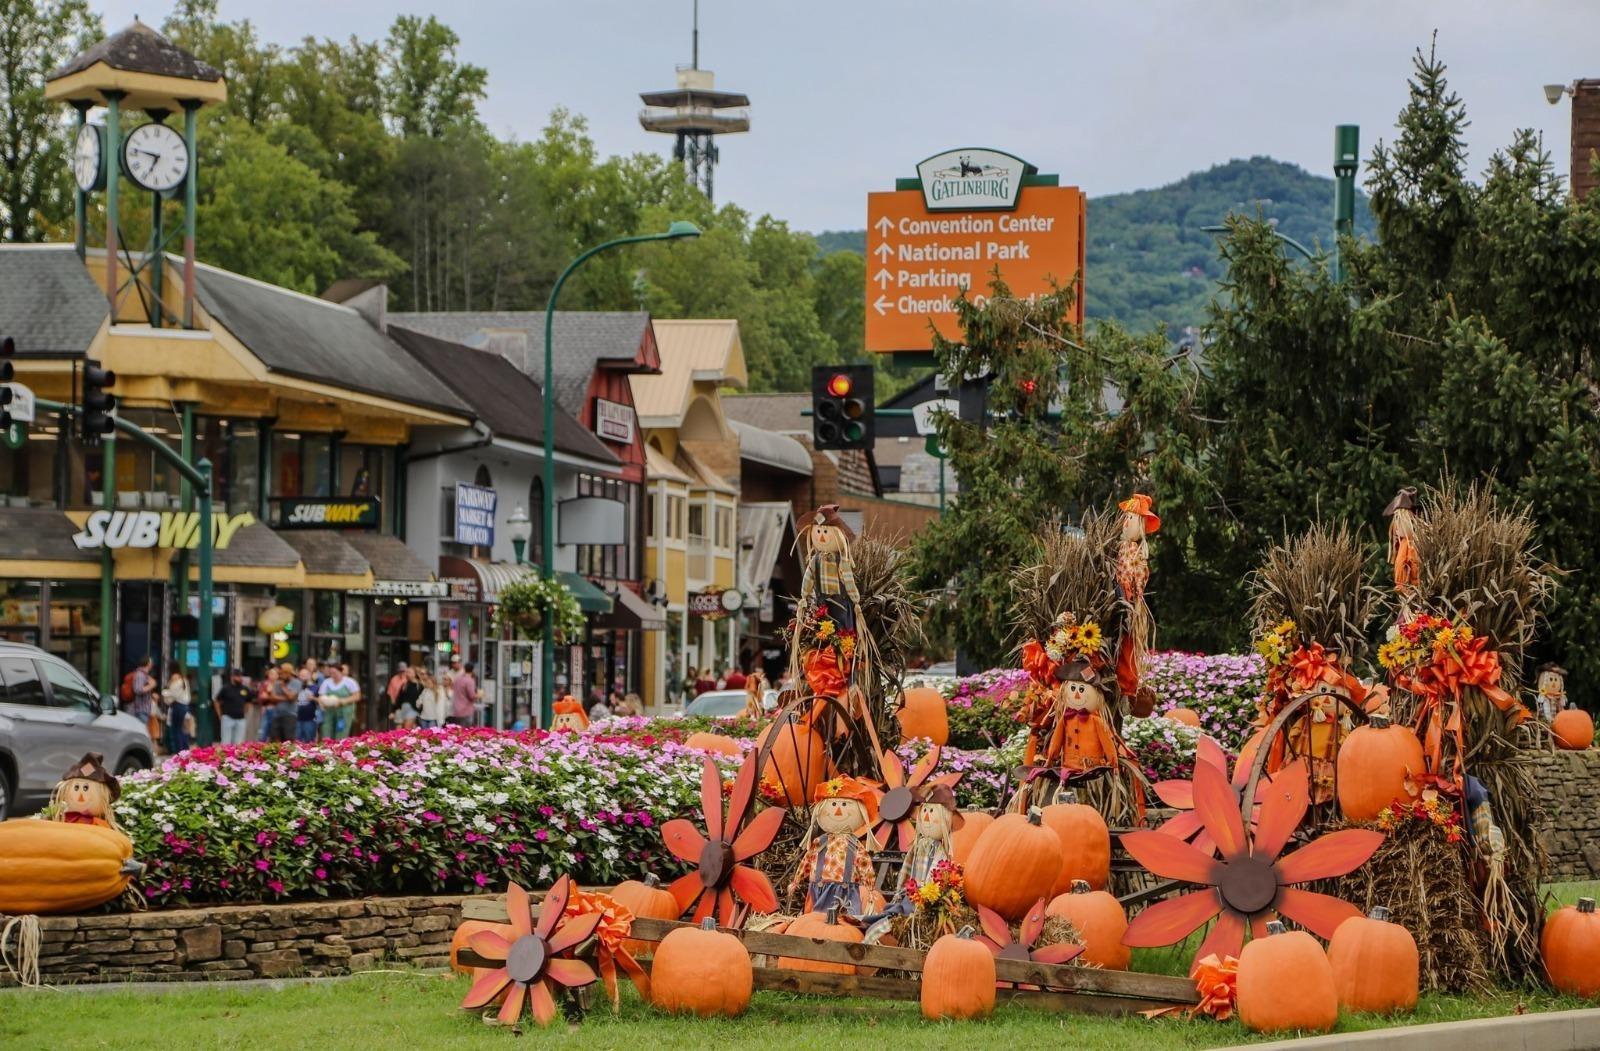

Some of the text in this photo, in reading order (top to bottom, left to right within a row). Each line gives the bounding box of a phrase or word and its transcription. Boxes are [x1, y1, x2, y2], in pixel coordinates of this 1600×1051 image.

[932, 177, 1009, 201] GATLINBURG
[899, 215, 1055, 235] Convention Center
[899, 240, 1030, 262] National Park
[898, 268, 971, 289] Parking
[459, 487, 496, 511] PARKWAY
[289, 504, 369, 523] SUBWAY
[459, 508, 487, 527] MARKET
[459, 525, 488, 545] TOBACCO
